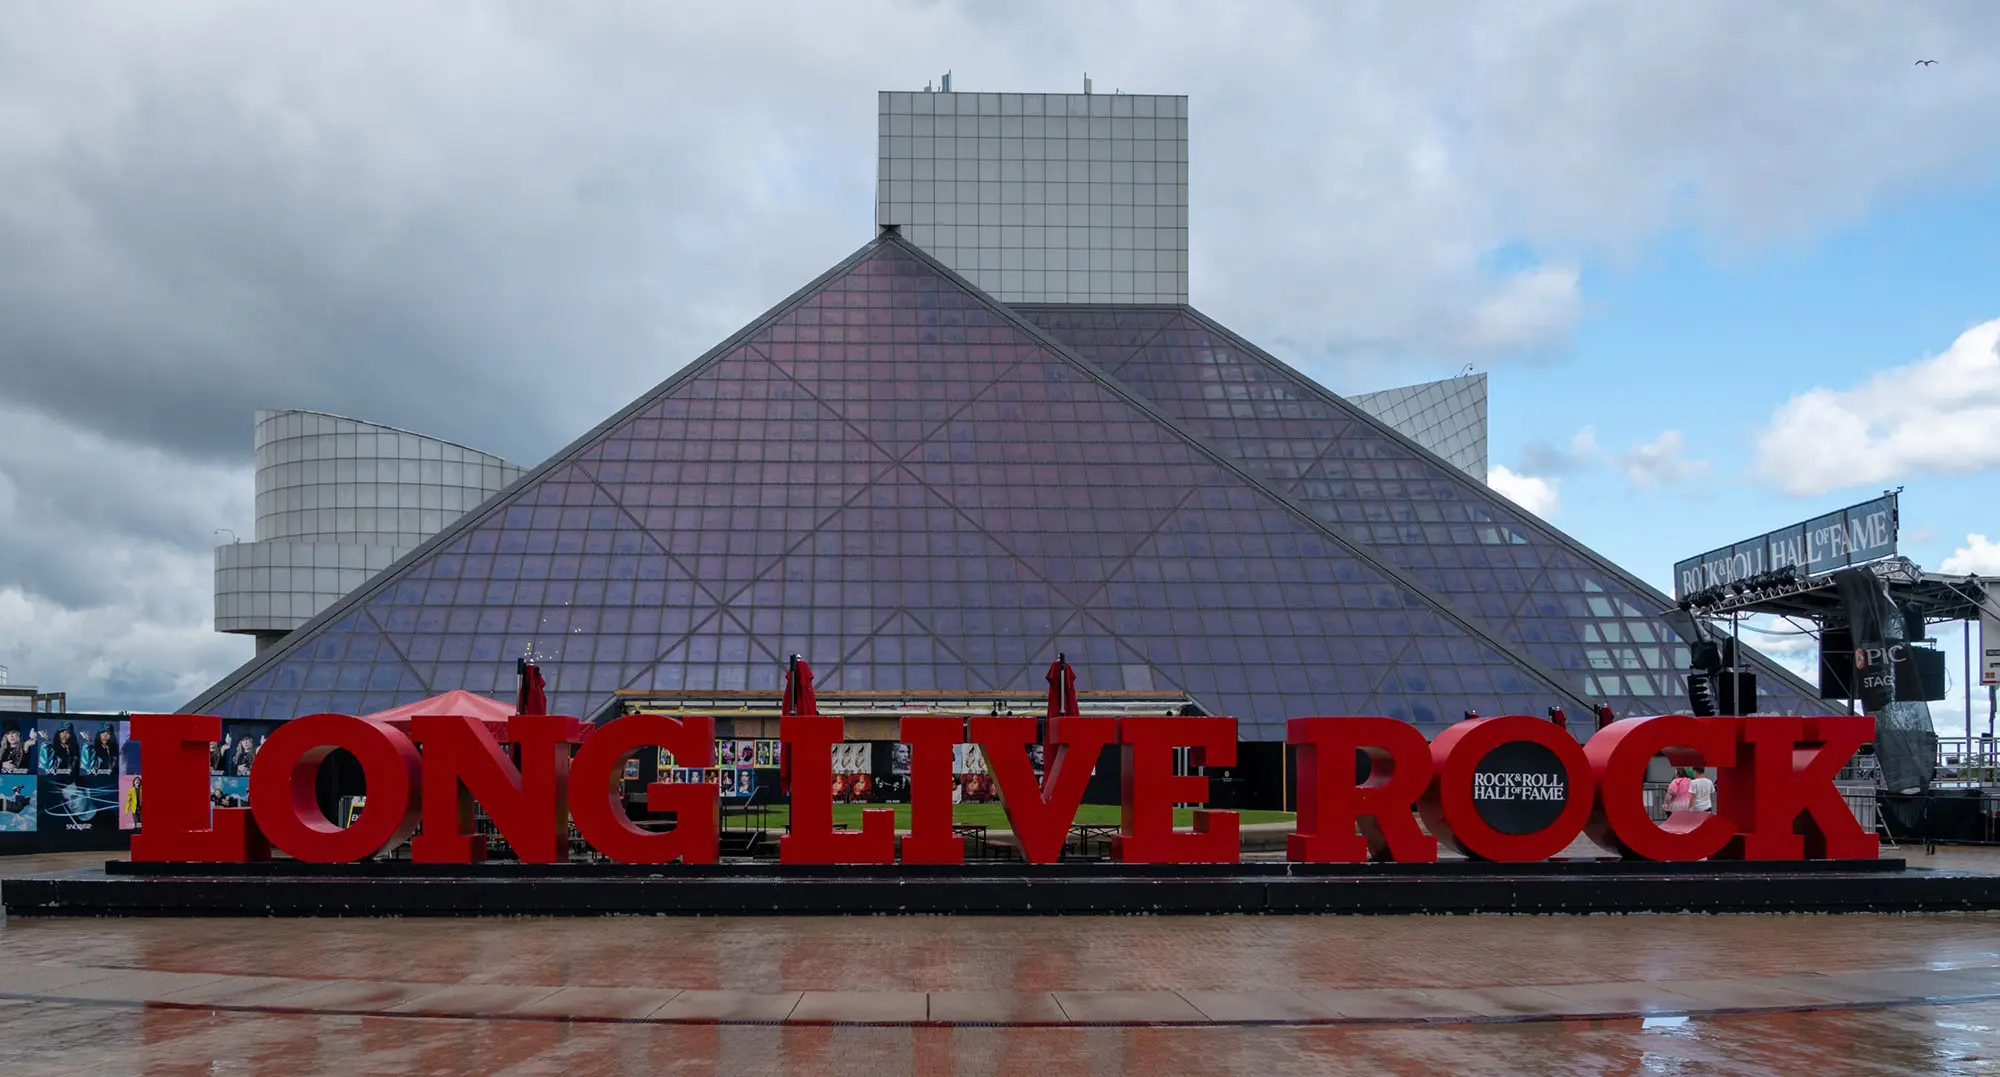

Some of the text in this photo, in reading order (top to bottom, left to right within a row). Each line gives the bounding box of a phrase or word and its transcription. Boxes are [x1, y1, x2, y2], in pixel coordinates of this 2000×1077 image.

[1771, 532, 1822, 570] HALL
[1829, 511, 1889, 558] FAME
[1864, 675, 1894, 688] STAG
[130, 713, 1878, 866] LONG LIVE ROCK
[1474, 786, 1564, 800] HALL OF FAME
